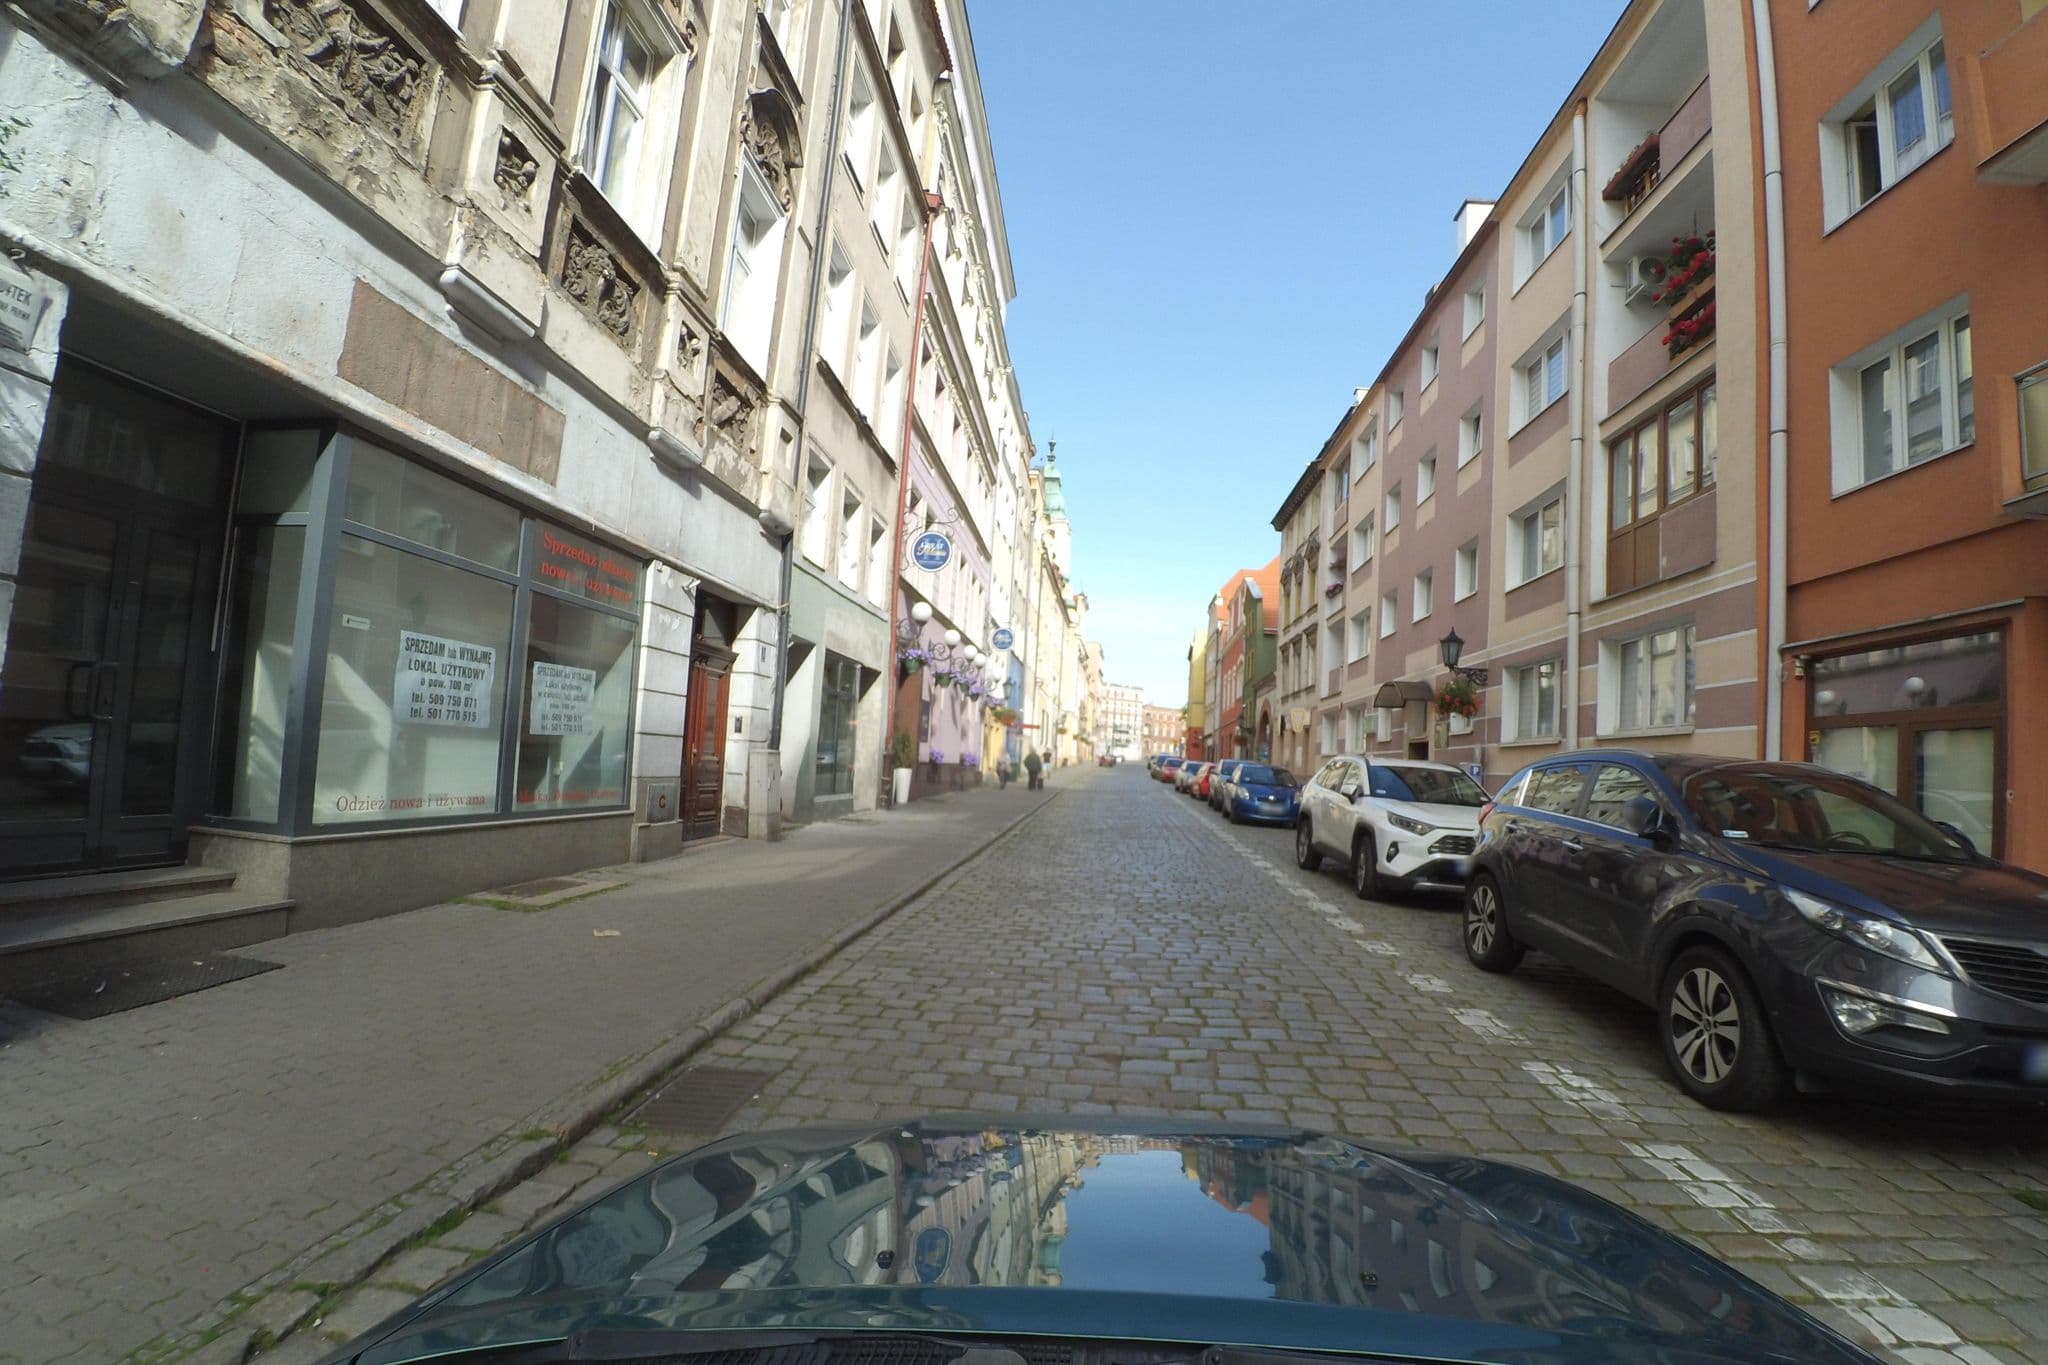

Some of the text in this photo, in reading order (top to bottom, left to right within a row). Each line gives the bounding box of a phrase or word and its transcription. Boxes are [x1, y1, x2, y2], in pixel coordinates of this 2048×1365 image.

[404, 636, 493, 668] SPRZEDAM lub WYNAJMĘ
[408, 658, 486, 680] LOKAL UŻYTKOWY
[428, 678, 446, 689] pow.
[449, 680, 462, 691] 100
[411, 692, 477, 709] tel. 509 750 071
[410, 706, 424, 718] tel.
[427, 707, 442, 719] 501
[446, 709, 460, 721] 770
[336, 795, 385, 812] Odzież
[390, 798, 424, 810] nowa
